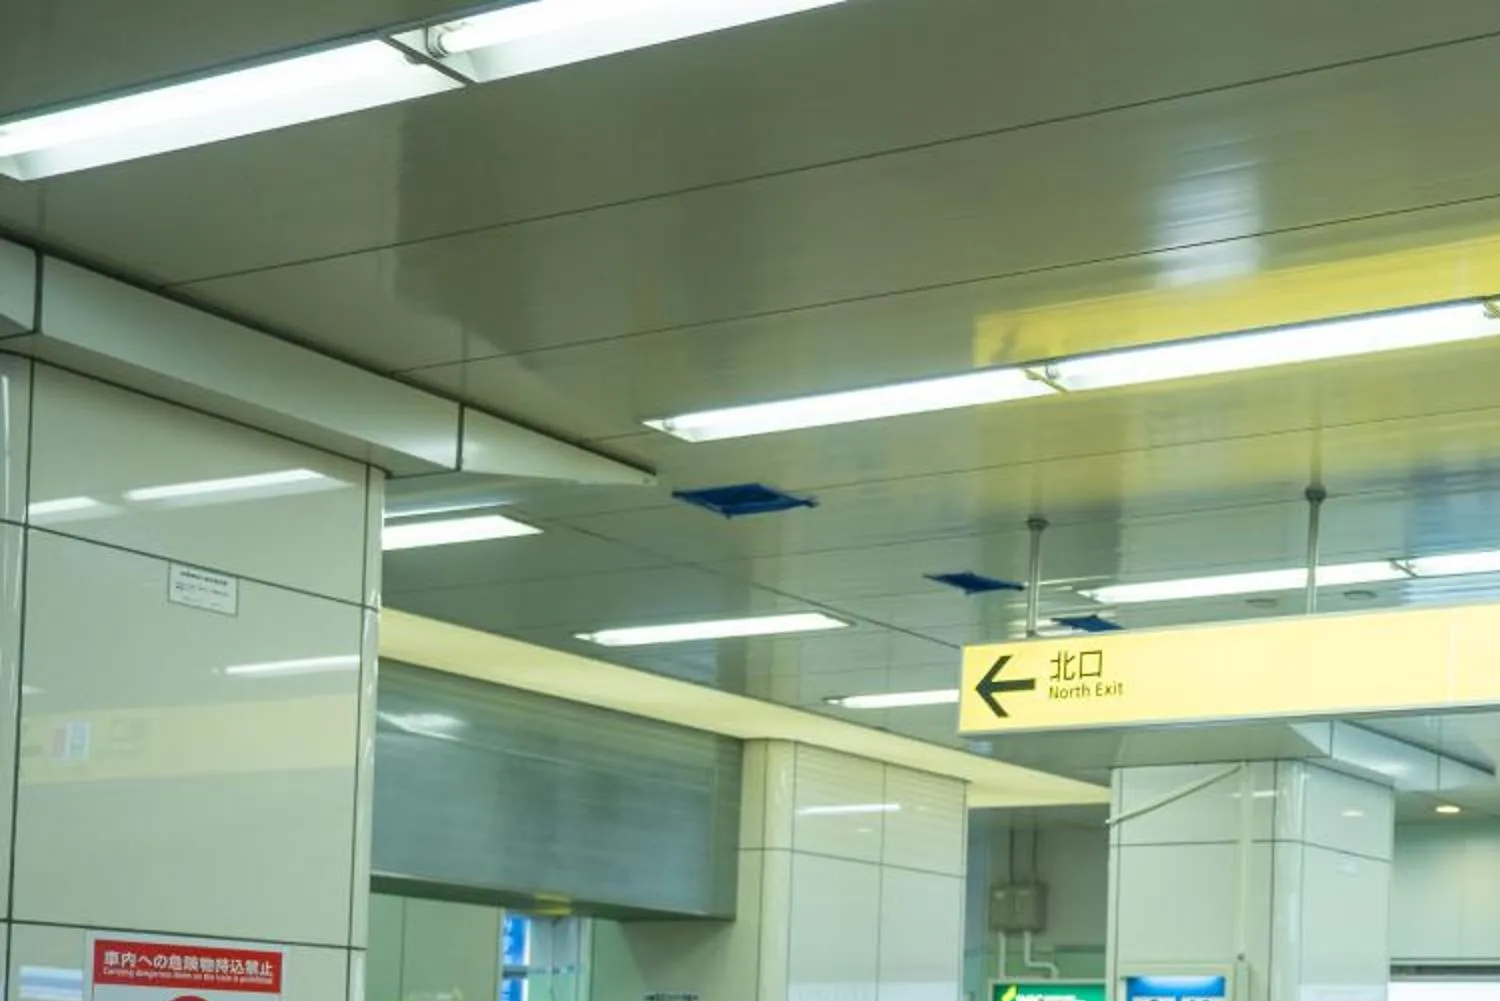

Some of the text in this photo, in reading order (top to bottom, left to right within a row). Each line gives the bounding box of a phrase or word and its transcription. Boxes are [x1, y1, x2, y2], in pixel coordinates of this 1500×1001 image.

[1050, 650, 1102, 682] 北口
[1049, 681, 1124, 700] North Exit
